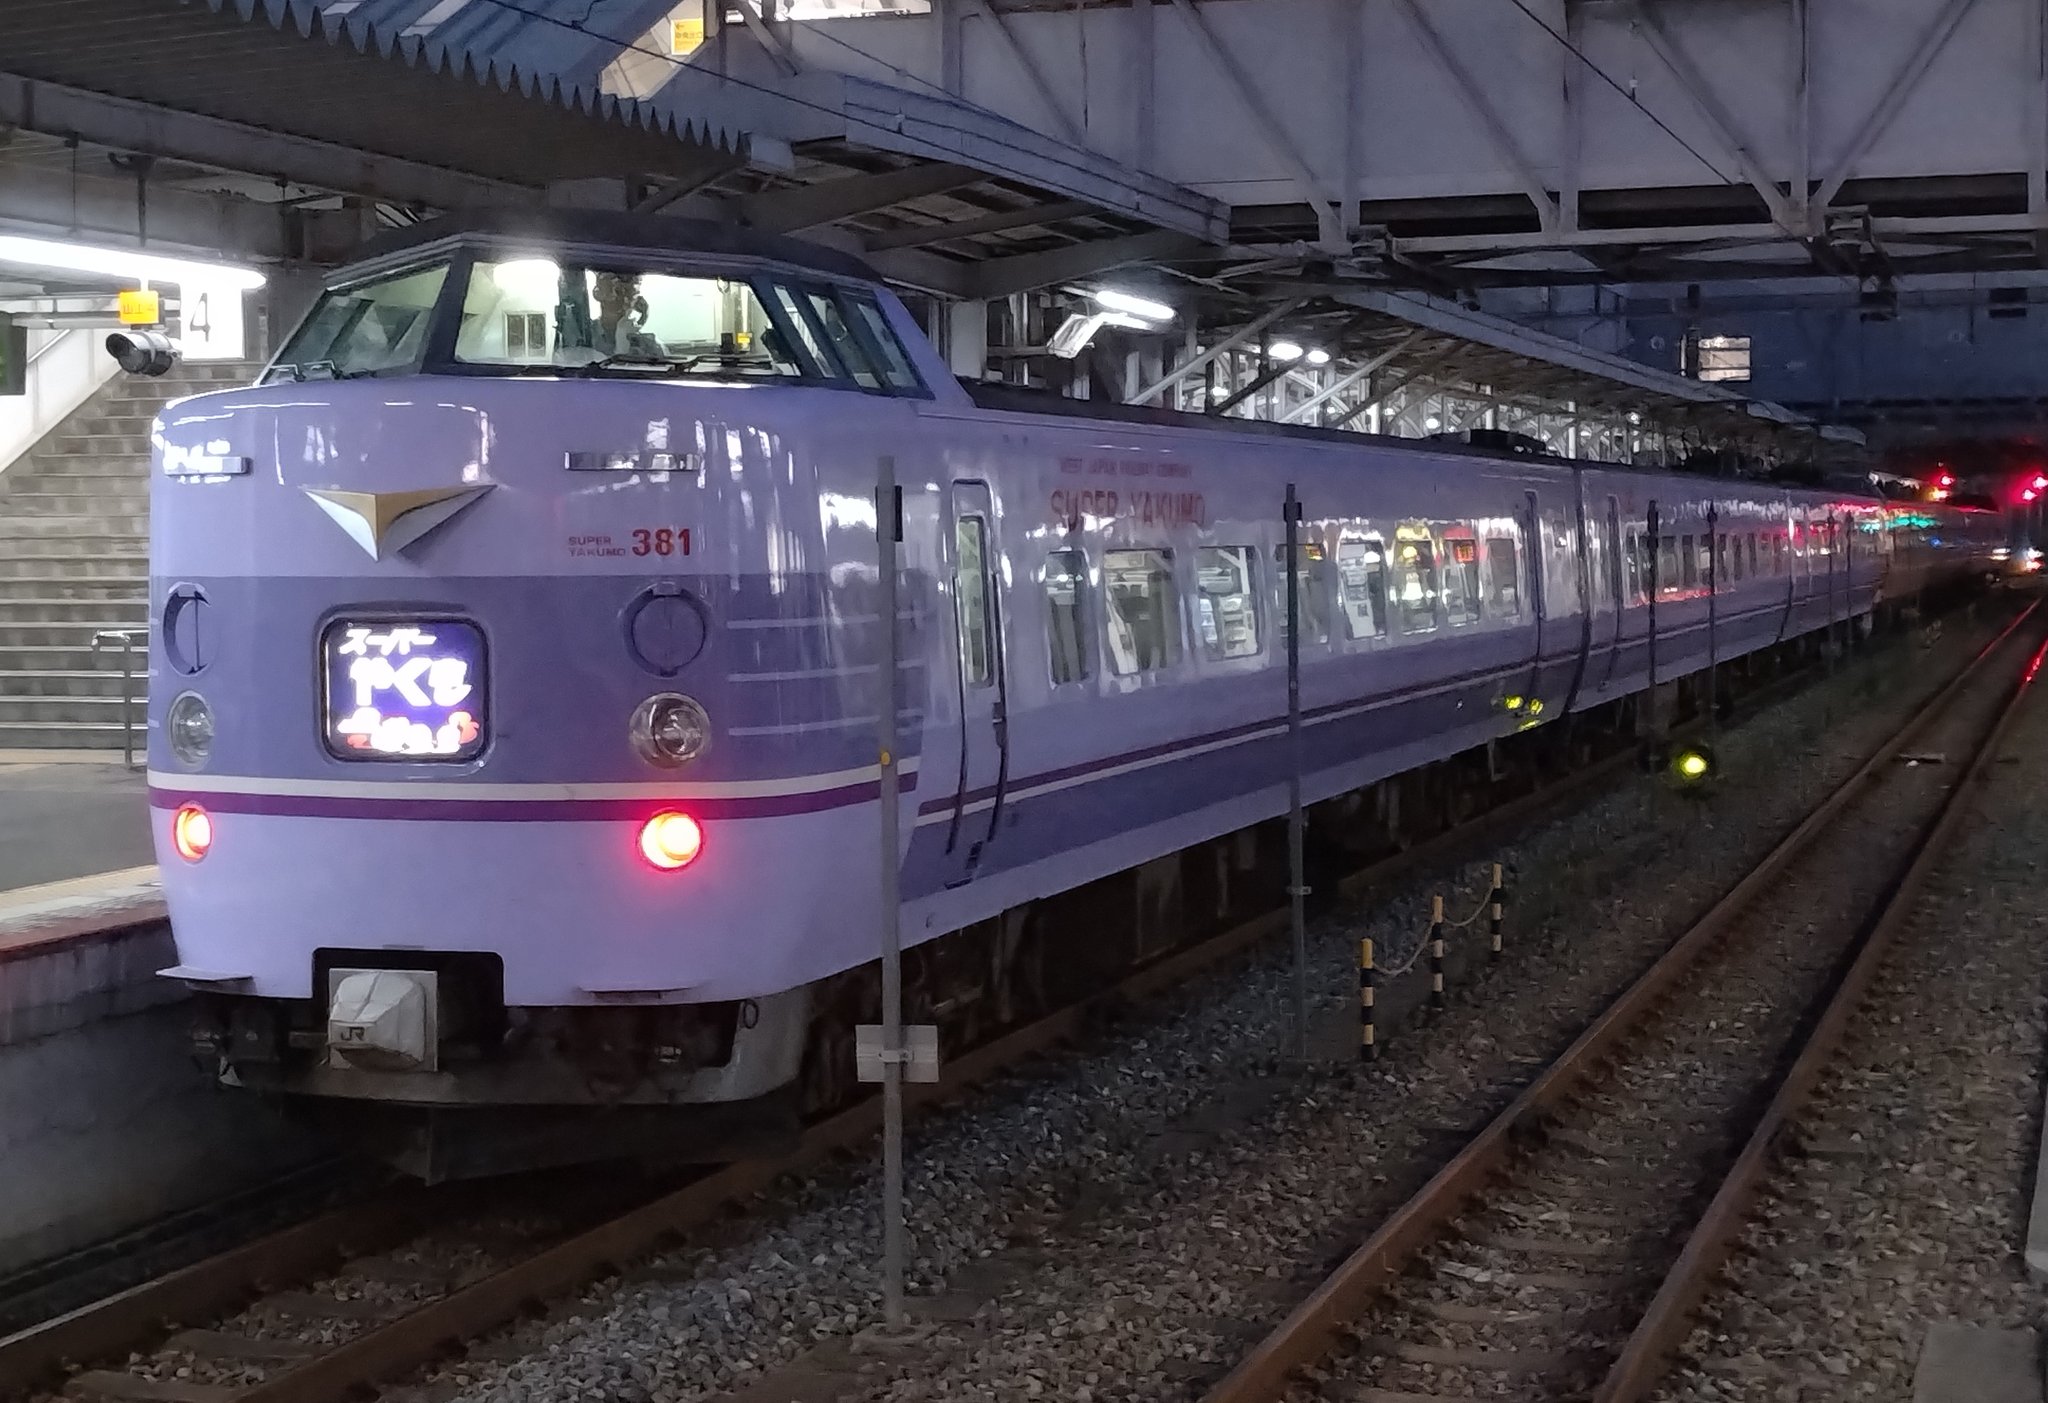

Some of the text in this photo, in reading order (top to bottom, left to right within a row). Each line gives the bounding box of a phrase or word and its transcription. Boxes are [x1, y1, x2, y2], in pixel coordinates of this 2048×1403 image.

[190, 292, 211, 342] 4
[568, 529, 691, 556] SUPER 381
[568, 547, 626, 558] YAKUMO
[340, 1025, 366, 1042] JR
